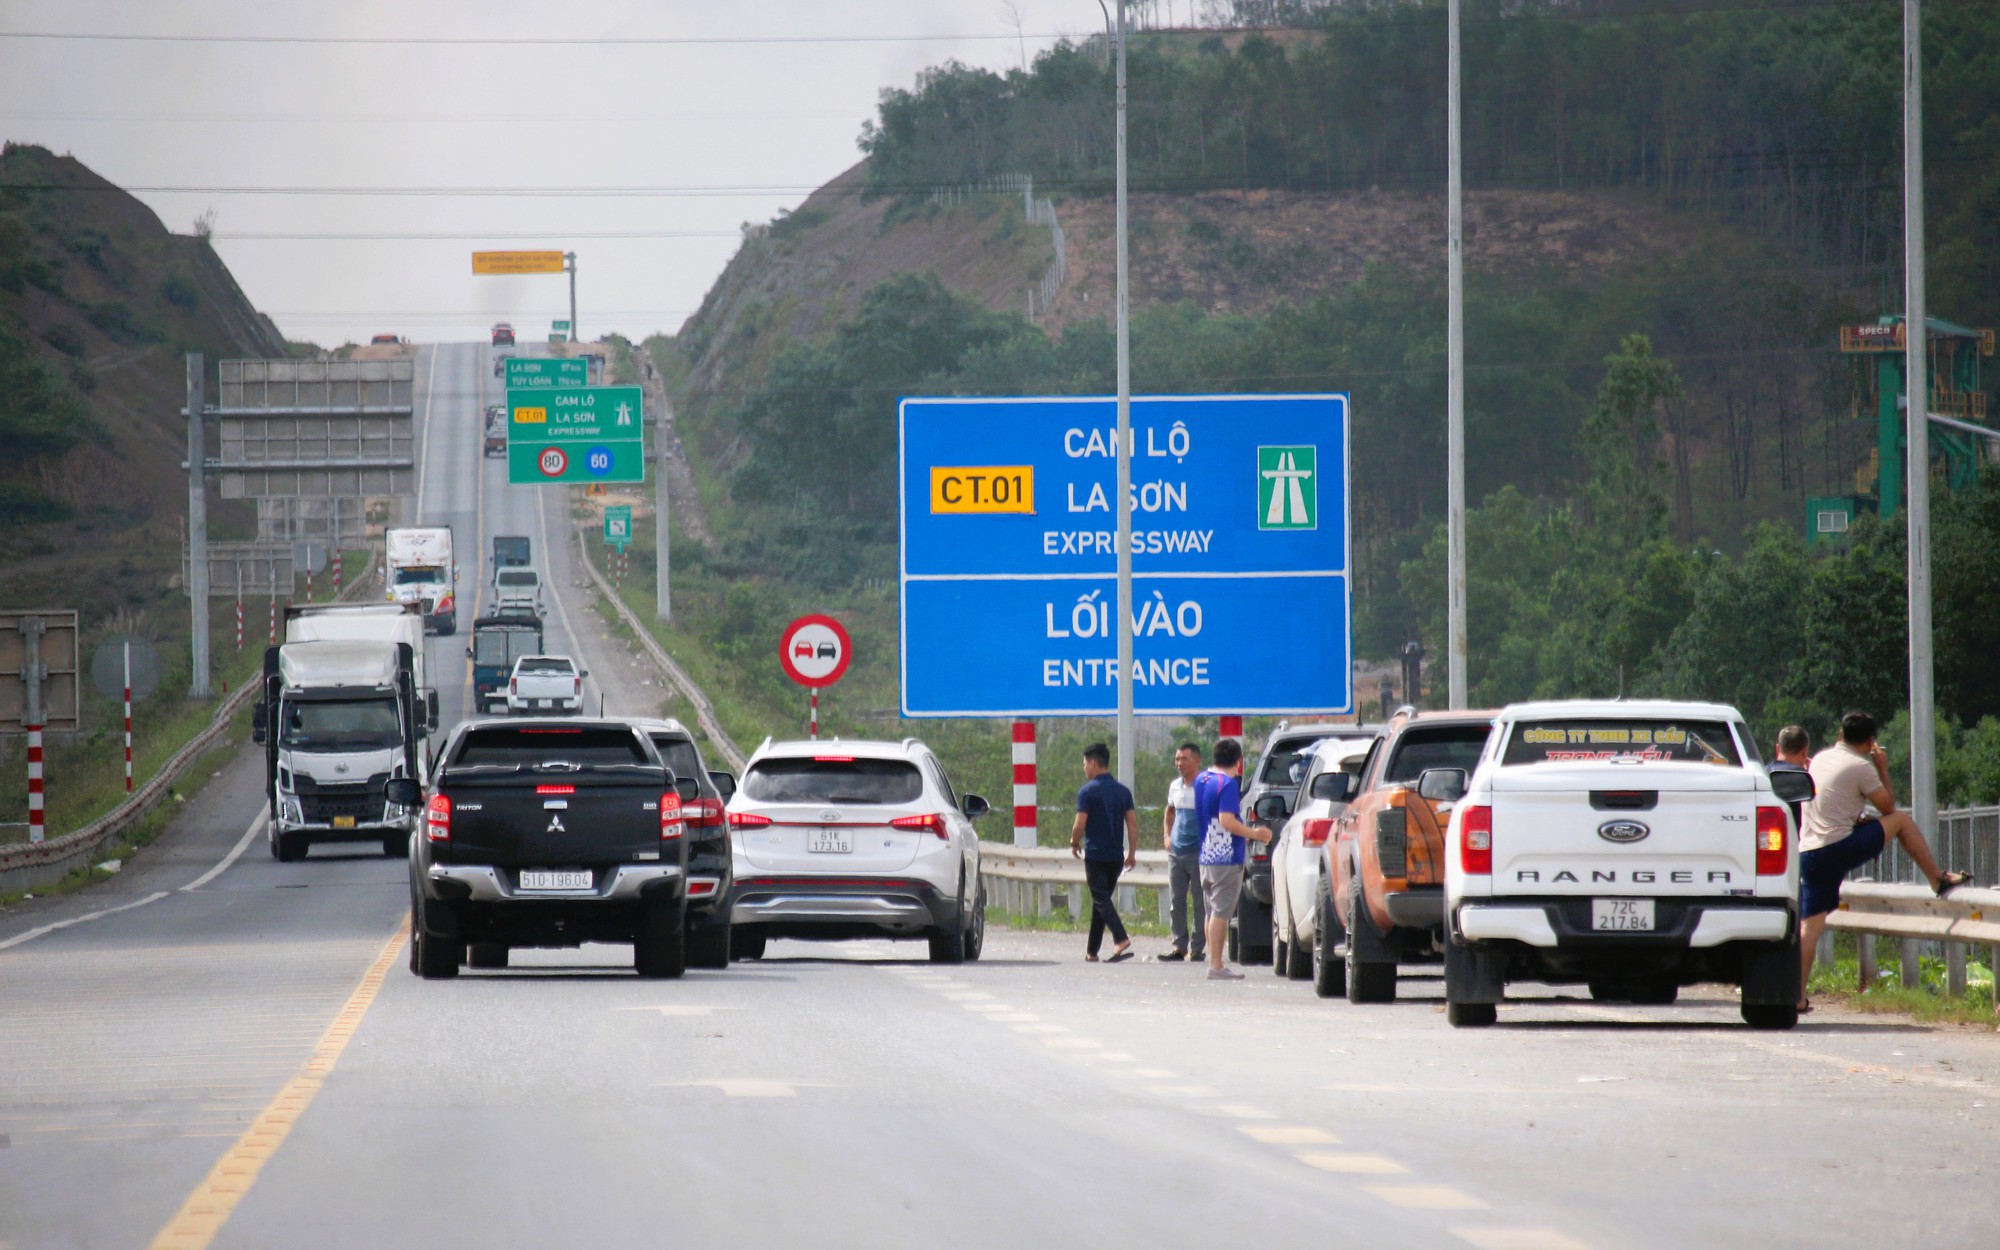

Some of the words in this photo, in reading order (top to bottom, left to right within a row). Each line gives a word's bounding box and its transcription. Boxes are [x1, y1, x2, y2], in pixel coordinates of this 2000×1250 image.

[555, 395, 578, 407] CAM
[517, 410, 543, 420] CT.01
[555, 412, 570, 423] LA
[547, 426, 600, 436] EXPRESSWAY
[1147, 420, 1190, 464] LỘ
[544, 455, 560, 468] 80
[590, 453, 608, 469] 60
[941, 475, 1022, 504] CT.01
[1067, 482, 1110, 512] LA
[1046, 588, 1108, 638] LỐI
[1131, 589, 1203, 638] VÀO
[1043, 657, 1210, 687] ENTRANCE
[1523, 727, 1566, 744] CÔNG
[1567, 729, 1587, 744] TY
[1588, 729, 1629, 744] TNHH
[1630, 729, 1652, 744] XE
[456, 803, 482, 811] TRITON
[1611, 825, 1637, 838] Ford
[813, 841, 848, 852] 173.16
[523, 873, 588, 887] 51D-196.04
[1517, 870, 1731, 883] RANGER
[1610, 901, 1637, 915] 72C
[1600, 916, 1648, 929] 217.84
